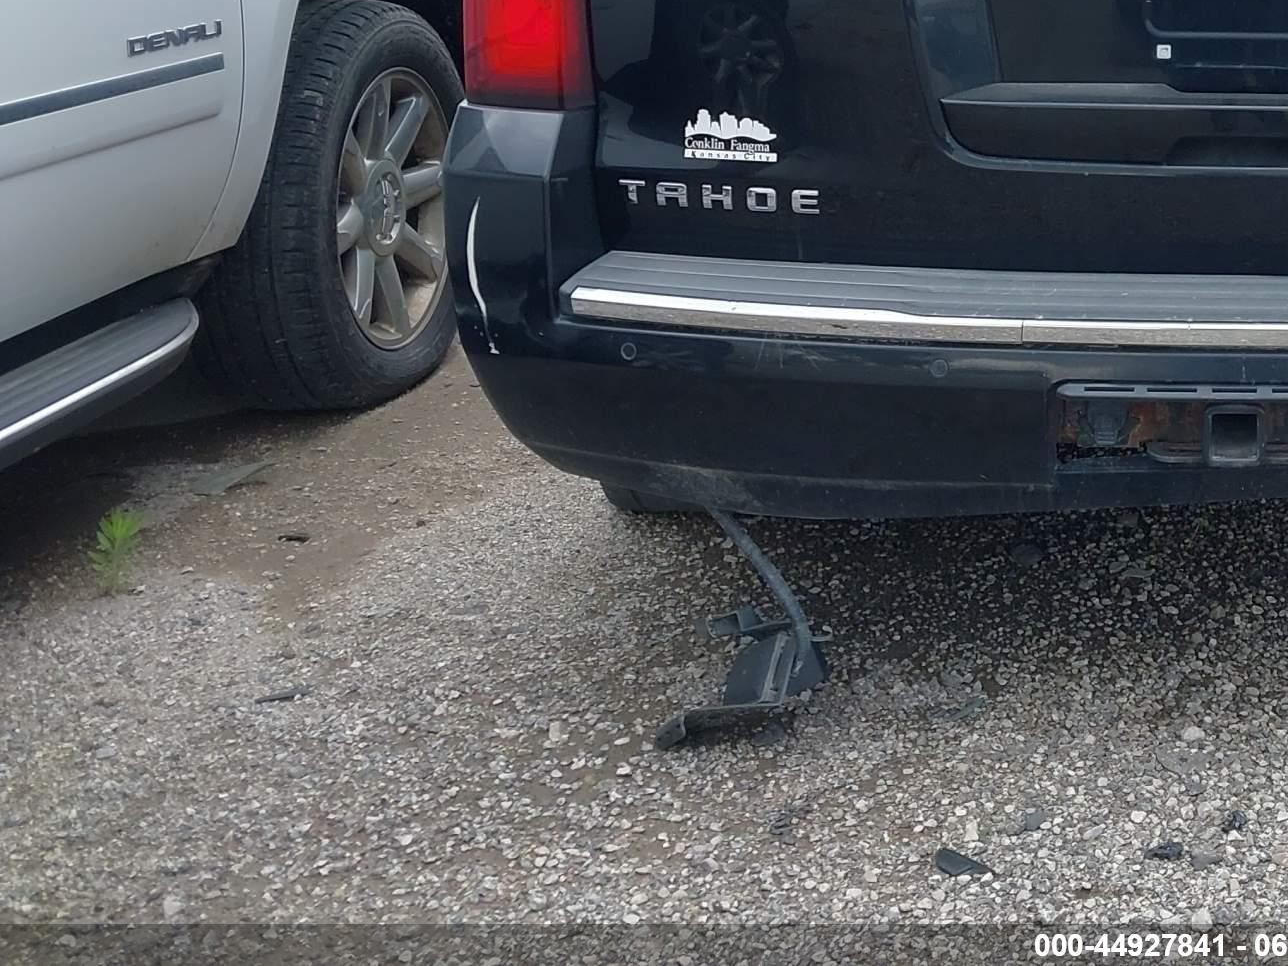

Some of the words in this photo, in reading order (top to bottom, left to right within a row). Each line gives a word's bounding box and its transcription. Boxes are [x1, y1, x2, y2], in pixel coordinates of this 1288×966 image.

[127, 19, 222, 57] DENALI
[684, 137, 725, 149] Conklin
[730, 139, 770, 155] Fangma
[690, 150, 737, 160] Kansas
[743, 152, 772, 162] City
[618, 179, 820, 215] TAHOE
